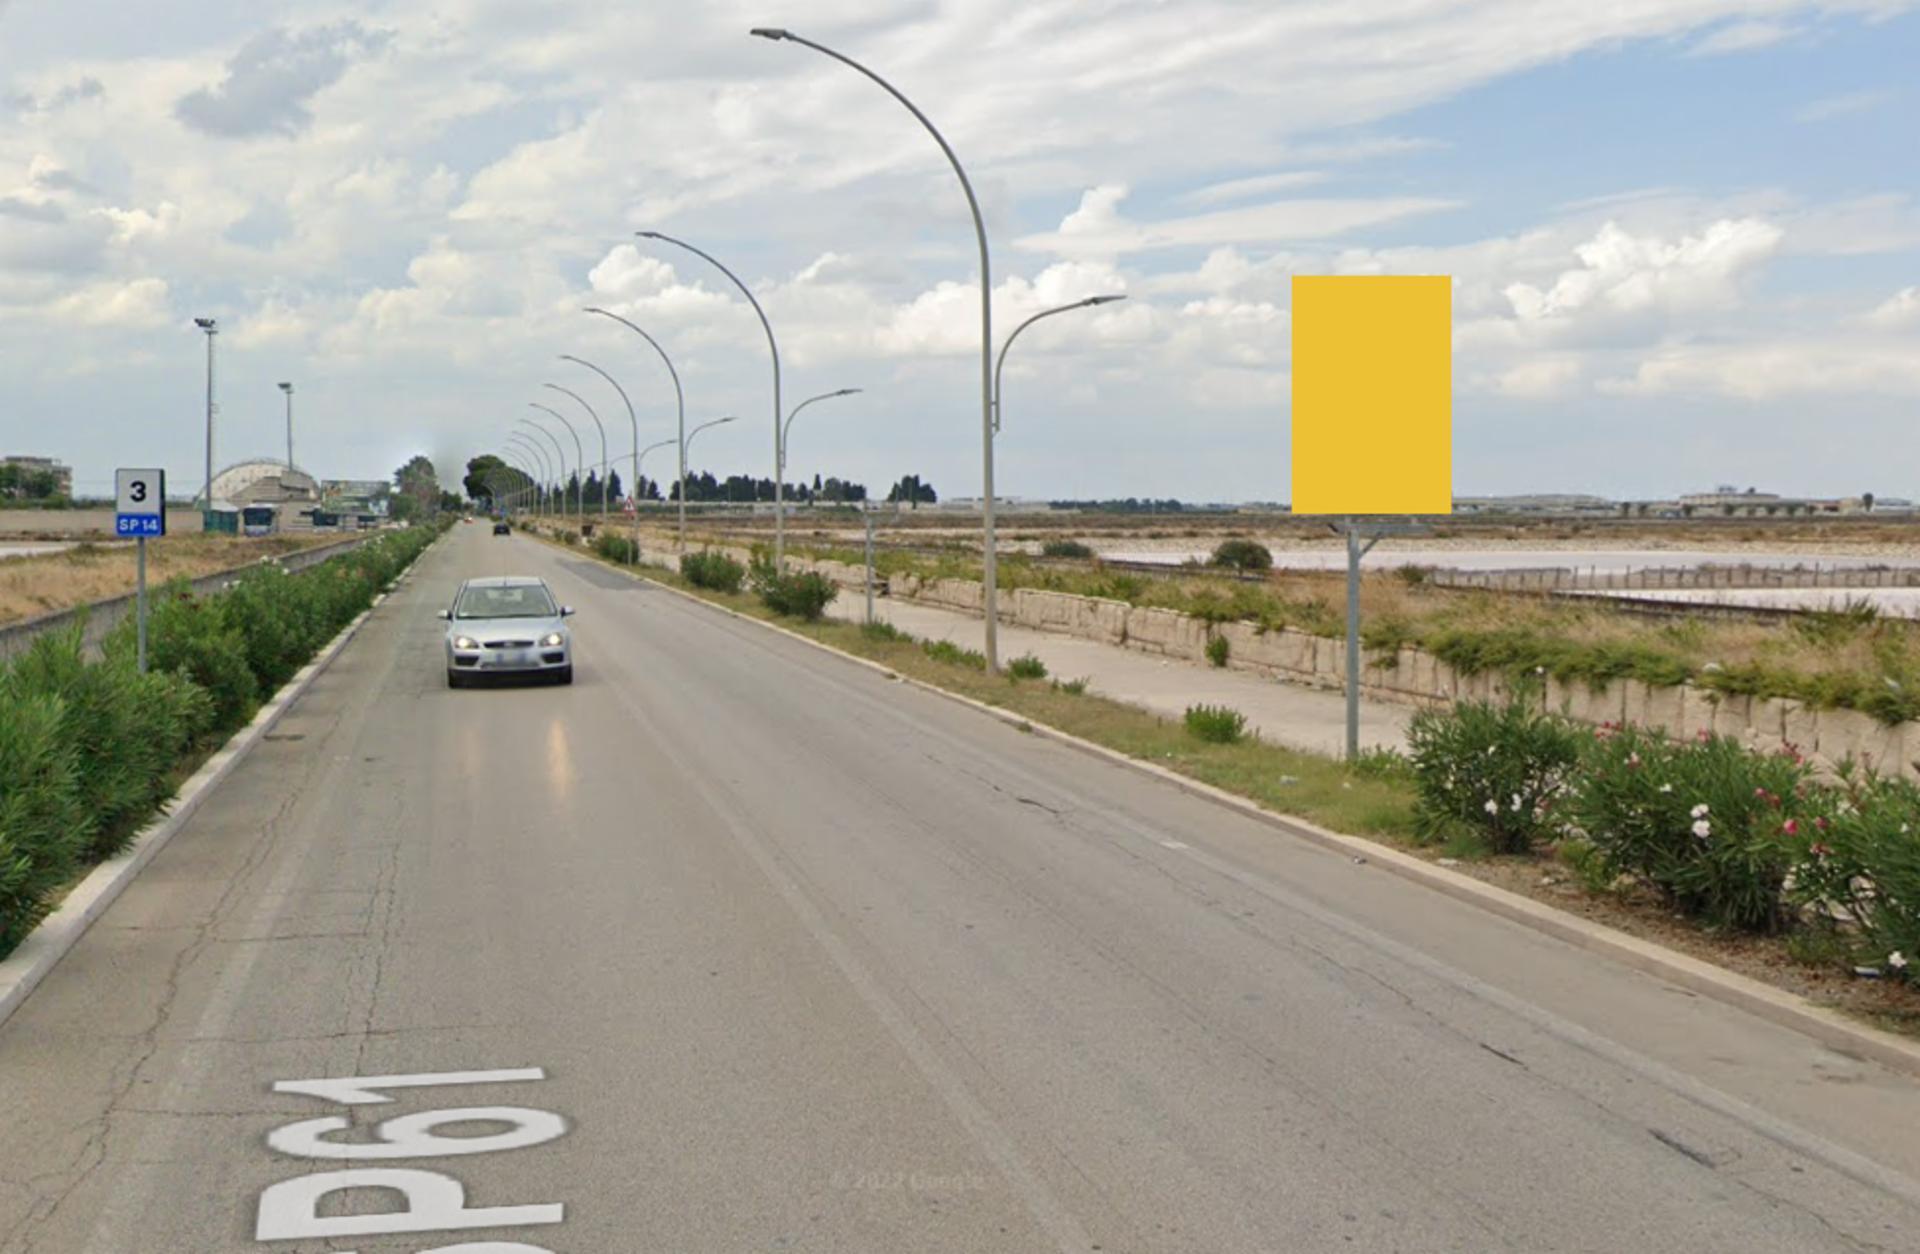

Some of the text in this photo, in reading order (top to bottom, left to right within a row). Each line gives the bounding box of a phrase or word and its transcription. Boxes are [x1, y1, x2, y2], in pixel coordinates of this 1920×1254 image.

[130, 481, 146, 502] 3
[119, 519, 158, 531] SP 14
[256, 1067, 570, 1254] P61
